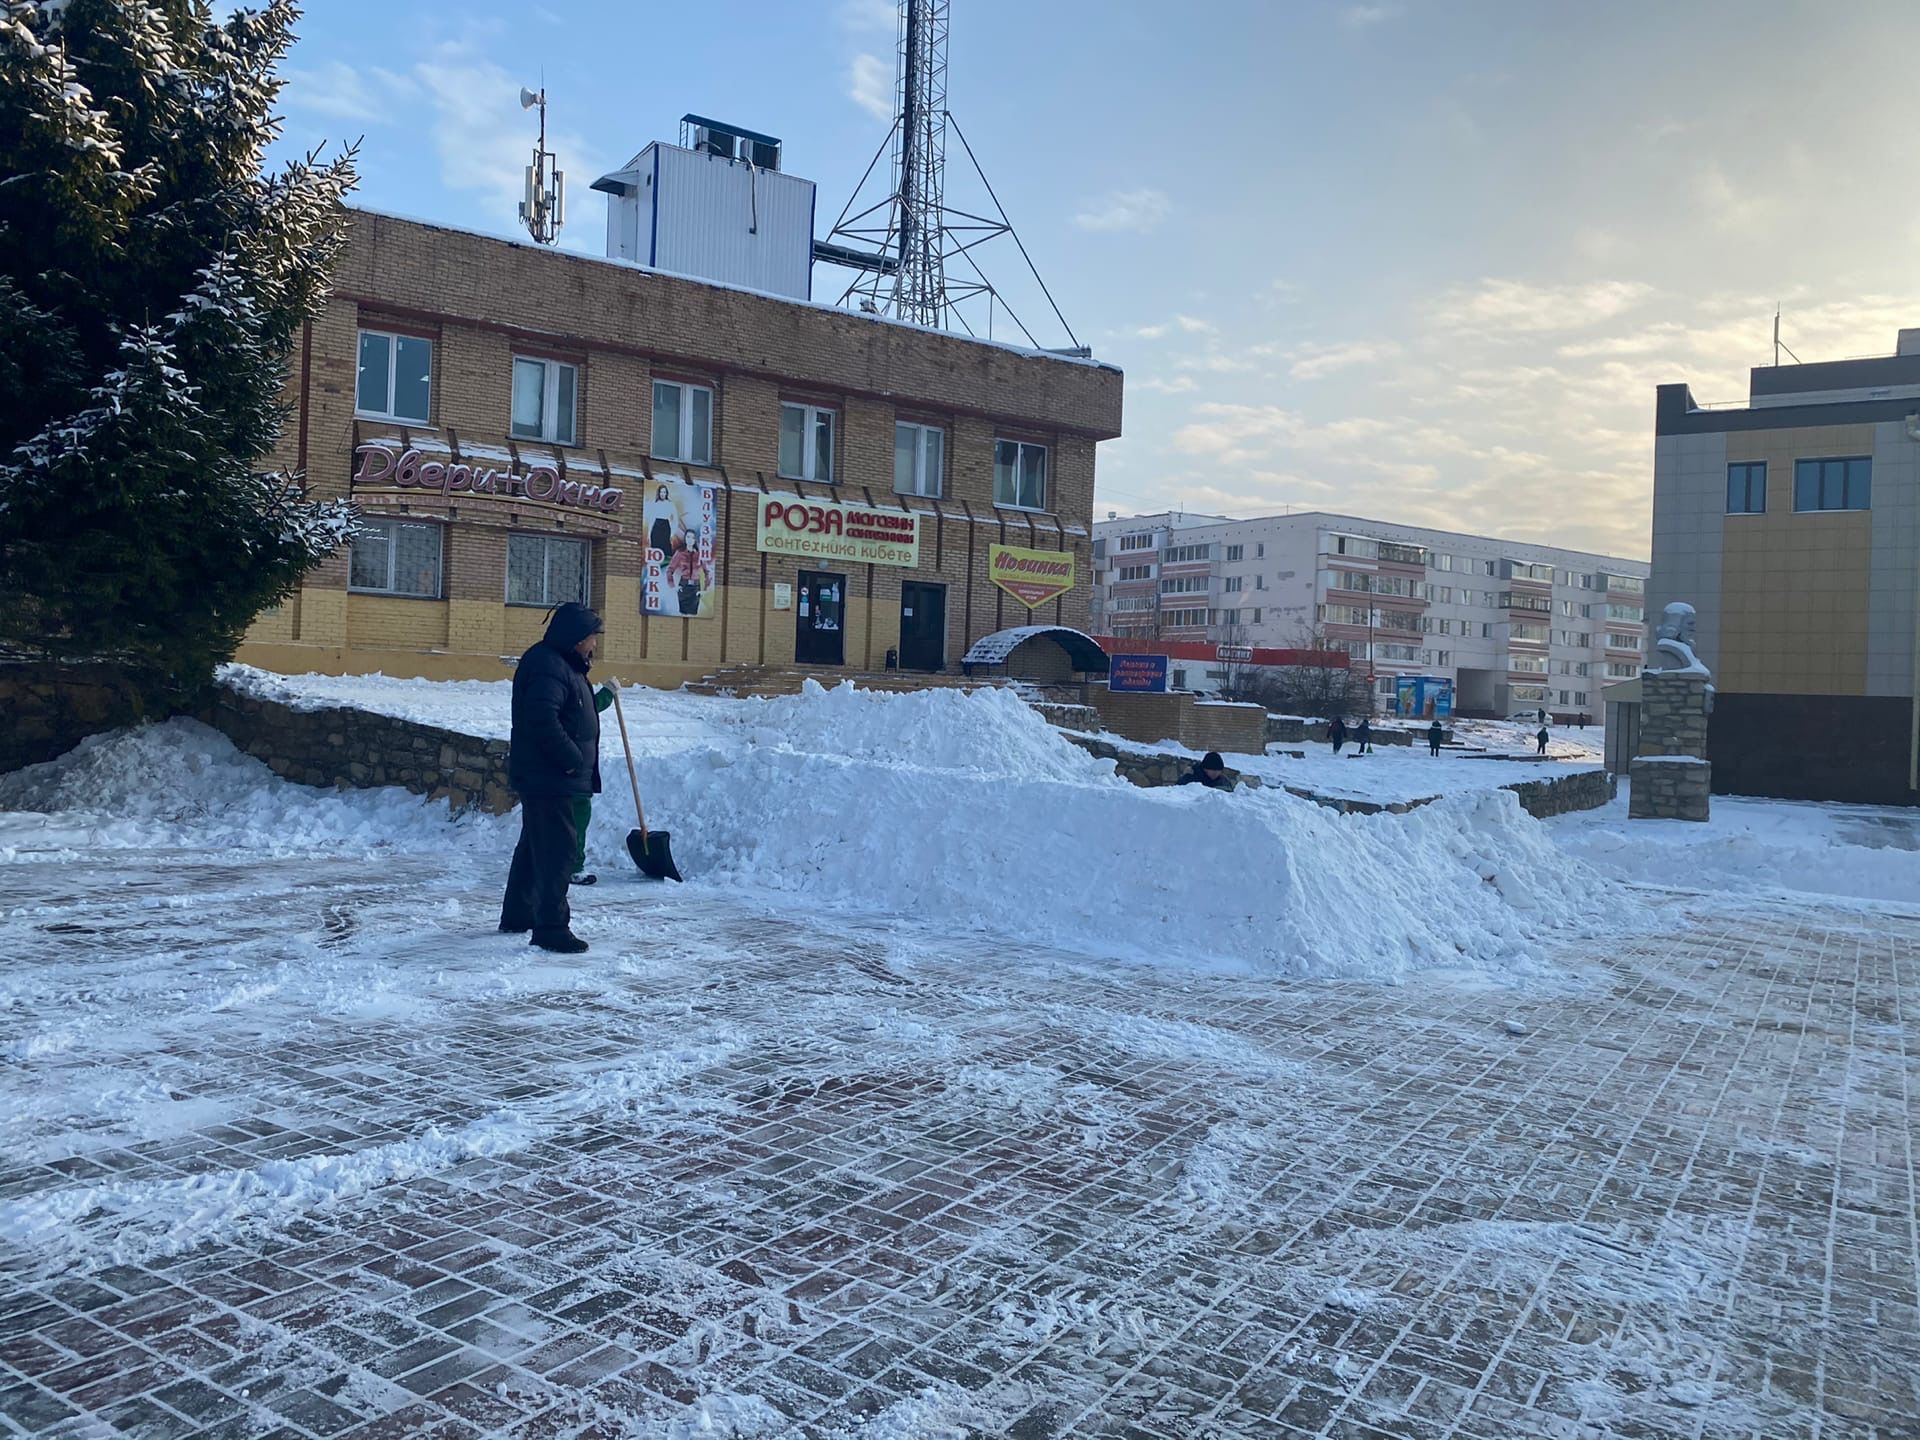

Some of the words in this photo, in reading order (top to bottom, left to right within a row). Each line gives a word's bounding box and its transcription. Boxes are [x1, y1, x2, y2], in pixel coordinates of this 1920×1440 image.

[701, 488, 713, 560] БЛУЗКИ
[764, 501, 844, 536] РОЗА
[764, 535, 857, 557] сантехника
[860, 545, 912, 563] кибете
[995, 551, 1073, 578] Новинка
[647, 549, 663, 609] ЮБКИ
